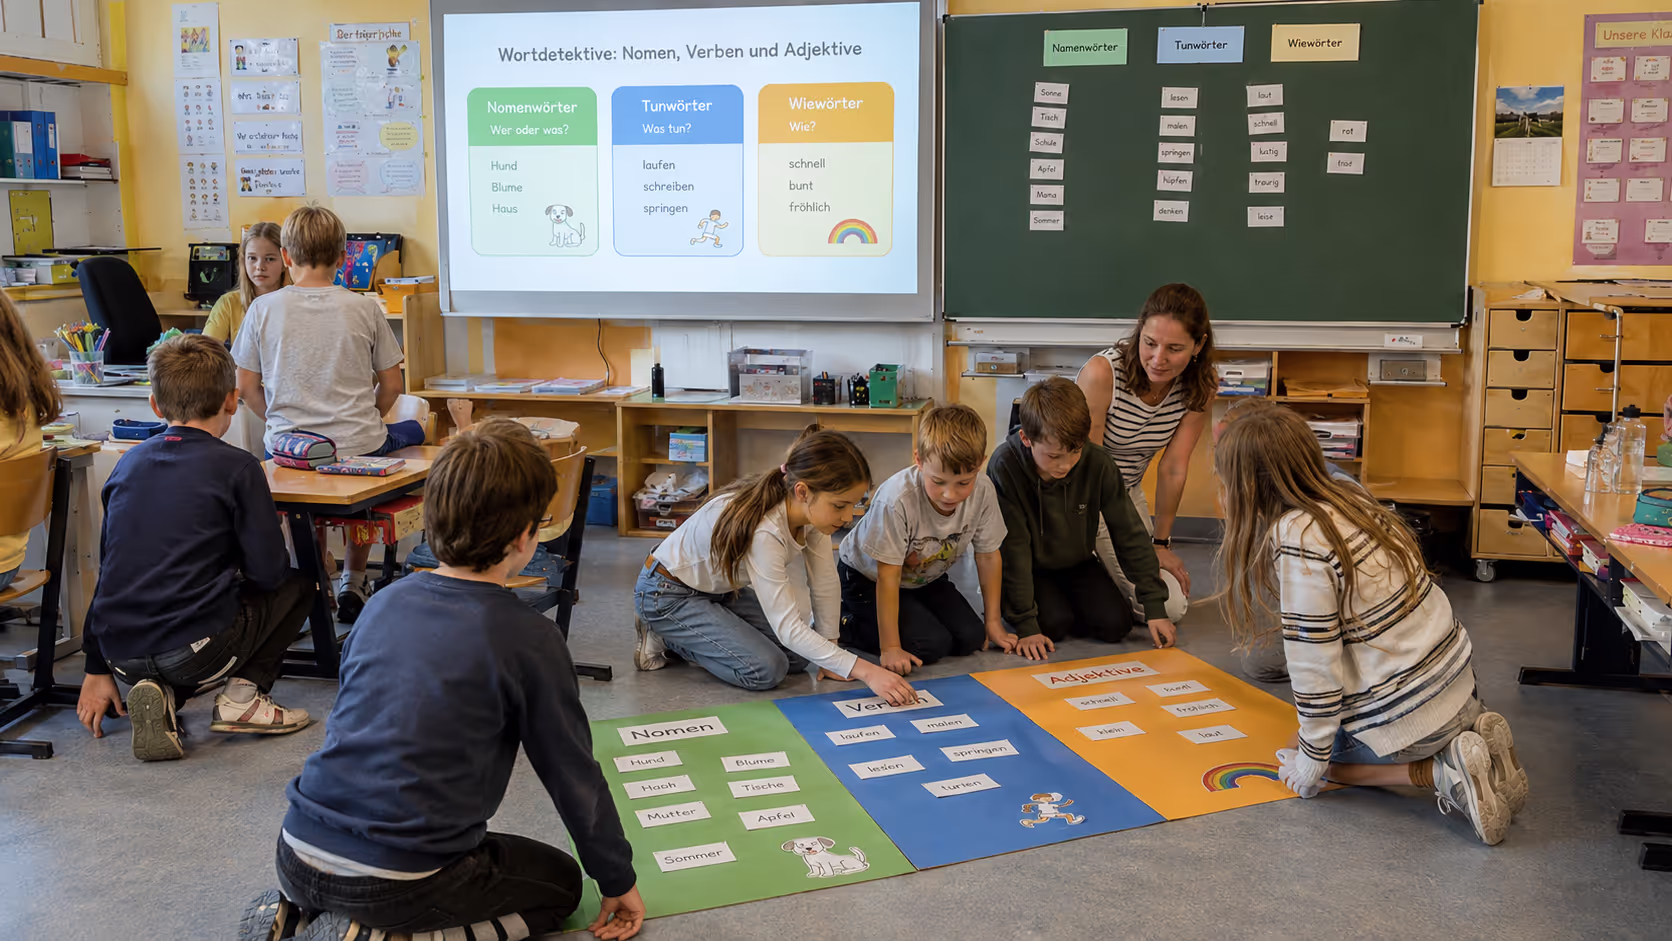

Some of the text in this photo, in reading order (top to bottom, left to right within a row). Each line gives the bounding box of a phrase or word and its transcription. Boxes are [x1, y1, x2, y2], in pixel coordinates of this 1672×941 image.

[1603, 28, 1672, 40] Unsere Kla
[1052, 42, 1119, 53] Namenwörter
[1174, 39, 1228, 50] Tunwörter
[1287, 37, 1343, 48] Wiewörter
[498, 41, 863, 62] Wortdetektive: Nomen, Verben und Adjektive
[1041, 89, 1062, 97] Sonne
[487, 100, 578, 114] Nomenwörter
[642, 99, 713, 113] Tunwörter
[788, 96, 864, 110] Wiewörter
[642, 123, 692, 134] Was tun?
[789, 121, 816, 132] Wie?
[1167, 122, 1188, 130] malen
[1254, 119, 1278, 128] schnell
[490, 124, 570, 136] Wer oder was?
[1161, 149, 1191, 158] springen
[490, 160, 518, 171] Hund
[642, 159, 676, 170] laufen
[789, 158, 826, 169] schnell
[1038, 165, 1056, 174] Apfel
[491, 182, 523, 193] Blume
[643, 181, 695, 192] schreiben
[789, 179, 814, 190] bunt
[1255, 179, 1279, 188] traurig
[492, 203, 519, 214] Haus
[643, 202, 689, 216] springen
[789, 201, 831, 213] fröhlich
[1158, 207, 1184, 215] denken
[1257, 212, 1274, 220] leise
[1050, 664, 1145, 684] Adjektive
[927, 719, 963, 729] malen
[631, 721, 714, 740] Nomen
[840, 730, 880, 740] laufen
[1096, 726, 1125, 735] klein
[1198, 730, 1224, 739] laut
[630, 755, 665, 766] Hund
[735, 756, 775, 767] Blume
[741, 782, 785, 792] Tische
[647, 807, 697, 821] Mutter
[757, 811, 795, 823] Apfel
[664, 848, 723, 865] Sommer
